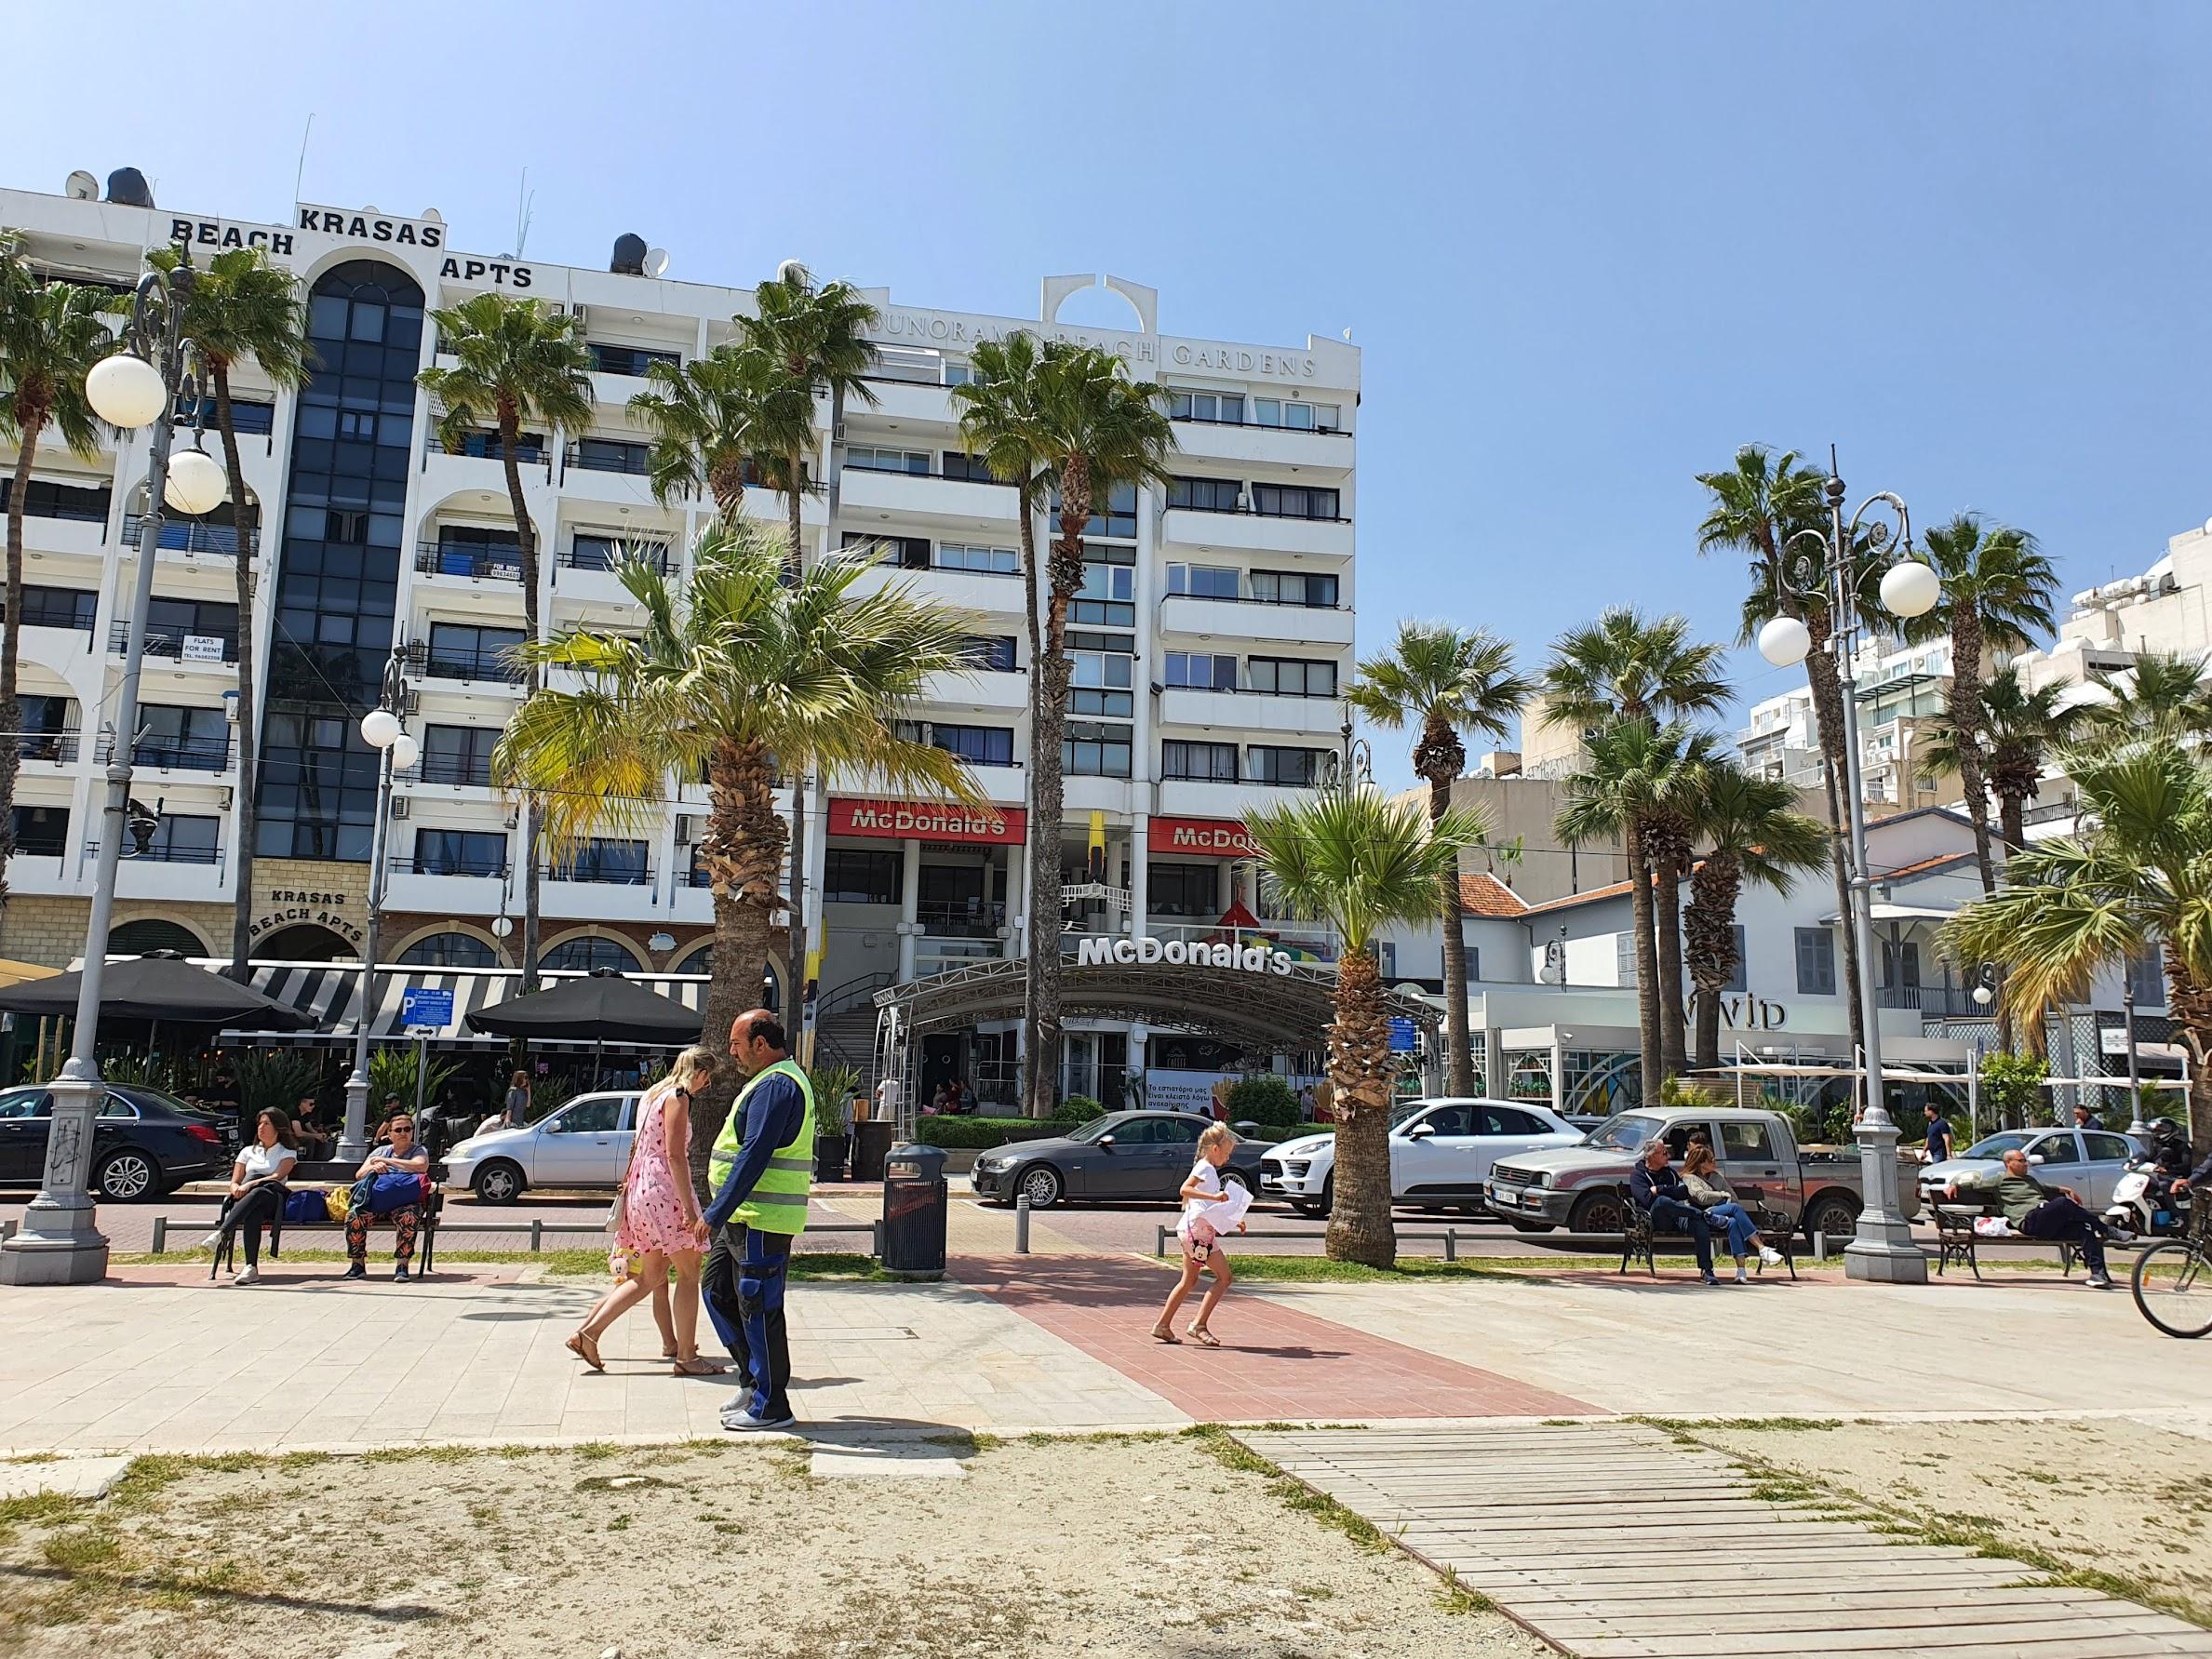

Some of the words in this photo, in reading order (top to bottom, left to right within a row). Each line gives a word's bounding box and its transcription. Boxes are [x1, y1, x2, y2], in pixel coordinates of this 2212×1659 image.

[170, 219, 294, 255] BEACH
[300, 209, 441, 248] KRASAS
[440, 258, 531, 288] APTS
[1172, 345, 1317, 377] GARDENS
[272, 890, 345, 904] KRASAS
[249, 908, 310, 937] BEACH
[316, 911, 363, 942] APTS
[1078, 937, 1293, 976] McDonald's
[402, 997, 416, 1015] P
[1158, 1085, 1193, 1093] εστιατόριο
[1165, 1092, 1190, 1101] κλειστό
[1192, 1093, 1210, 1103] λόγω
